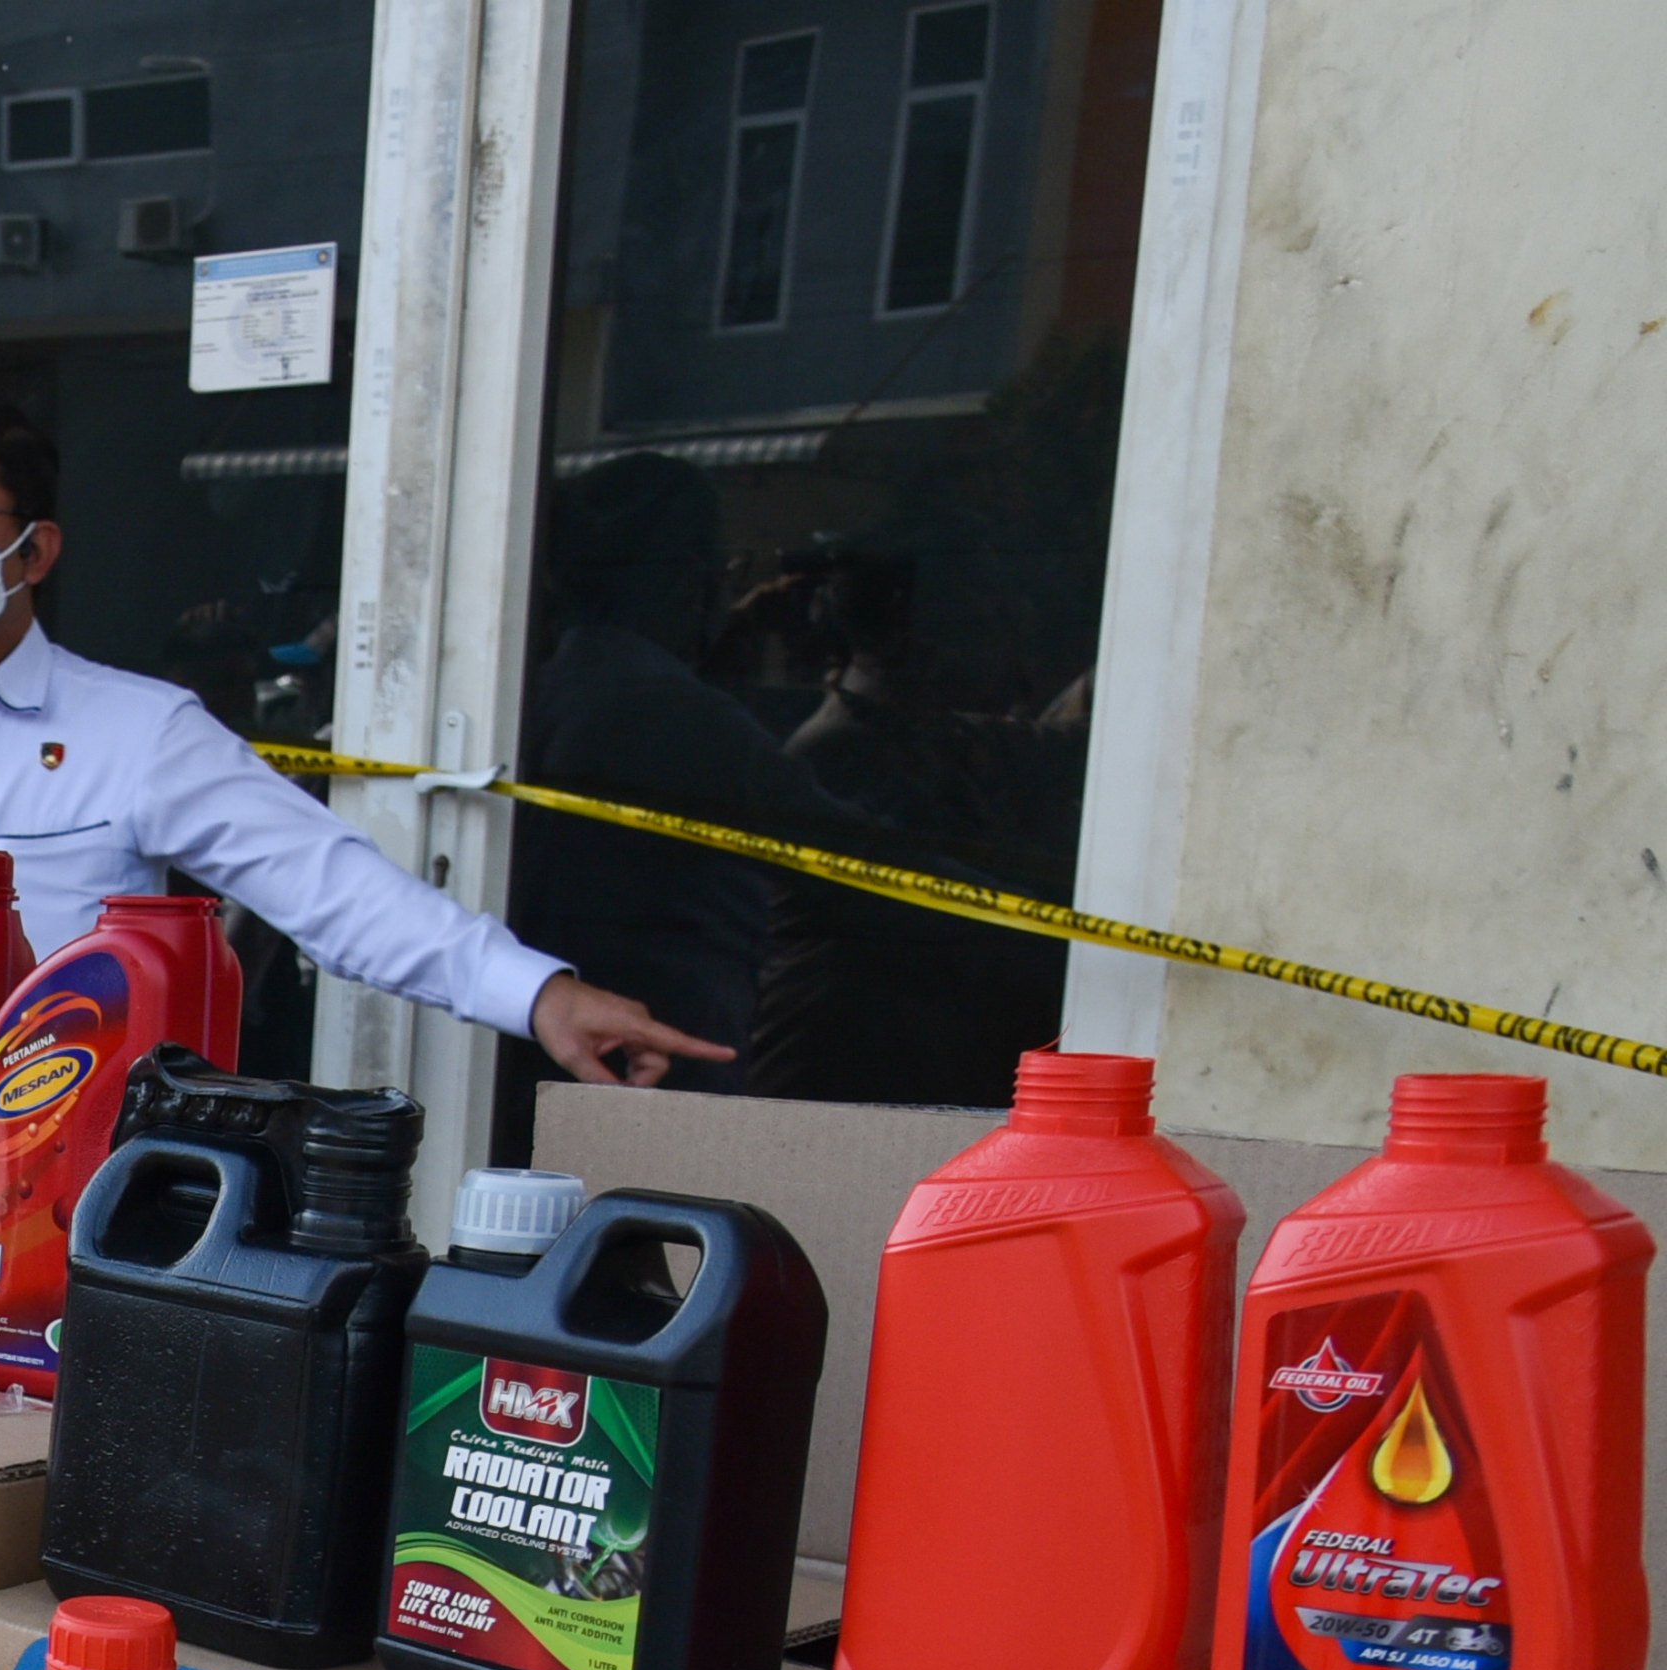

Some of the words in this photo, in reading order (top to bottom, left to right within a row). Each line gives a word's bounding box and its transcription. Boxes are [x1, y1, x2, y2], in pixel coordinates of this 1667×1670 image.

[2, 1033, 56, 1068] PERTAMINA
[1, 1062, 74, 1106] MESRAN
[917, 1184, 1055, 1228] FEDERAL
[1281, 1221, 1434, 1268] FEDERAL
[1276, 1371, 1342, 1389] FEDERAL
[1345, 1378, 1370, 1391] OIL
[488, 1377, 579, 1428] HMX
[443, 1445, 611, 1511] RADIATOR
[571, 1454, 609, 1473] Mesin
[451, 1486, 597, 1546] COOLANT
[444, 1520, 499, 1543] ADVANCED
[500, 1531, 547, 1552] COOLING
[548, 1543, 593, 1561] SYSTEM
[1302, 1530, 1393, 1555] FEDERAL
[1289, 1550, 1501, 1607] UltraTec
[399, 1596, 427, 1618] LIFE
[429, 1602, 496, 1633] COOLANT
[404, 1580, 448, 1604] SUPER
[452, 1590, 491, 1614] LONG
[534, 1616, 554, 1629] ANTI
[556, 1620, 578, 1635] RUST
[581, 1627, 623, 1646] ADDITIVE
[547, 1605, 568, 1618] ANTI
[570, 1612, 625, 1633] CORROSION
[1309, 1615, 1392, 1640] 20W-50
[1407, 1628, 1438, 1645] 4T
[1359, 1648, 1386, 1661] API
[1387, 1650, 1407, 1663] SJ
[1408, 1652, 1450, 1669] JASO
